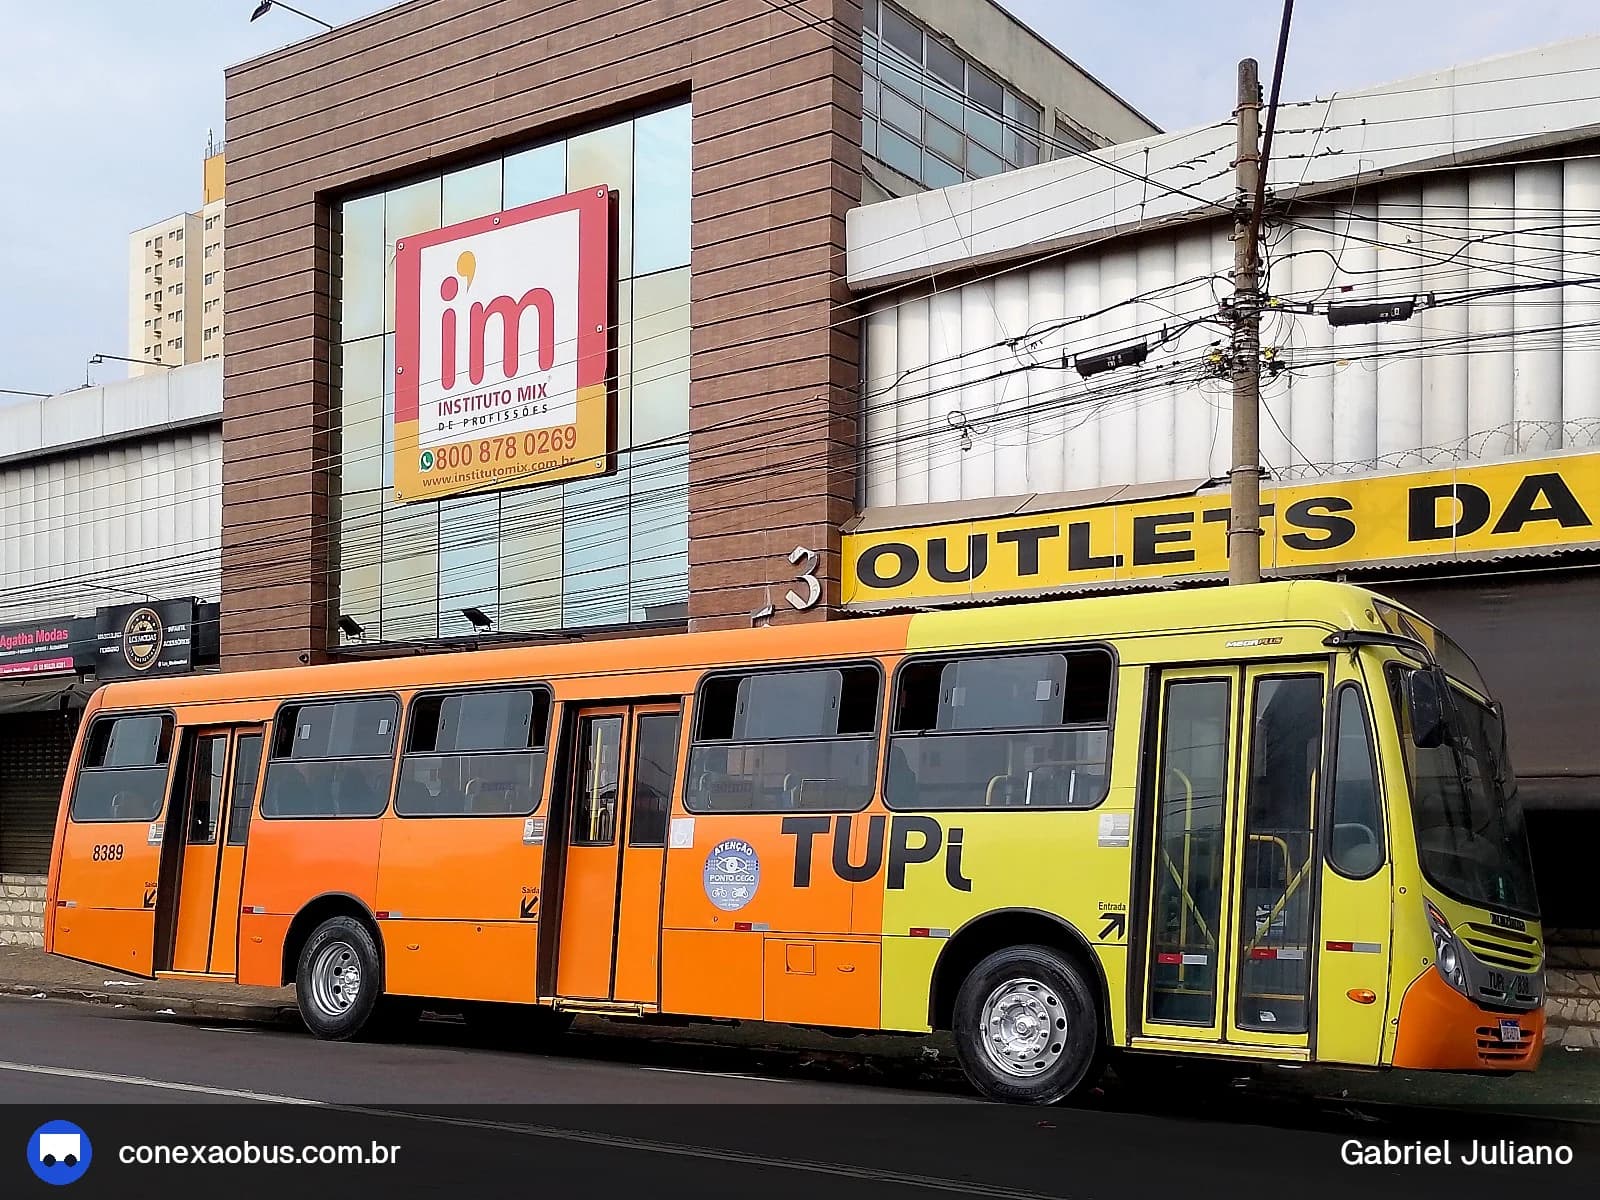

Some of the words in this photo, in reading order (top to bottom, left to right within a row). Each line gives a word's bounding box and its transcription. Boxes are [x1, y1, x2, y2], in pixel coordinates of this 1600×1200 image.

[438, 389, 511, 416] INSTITUTO
[517, 382, 548, 402] MIX
[438, 420, 453, 431] DE
[463, 404, 548, 427] PROFISSÕES
[436, 444, 473, 470] 800
[479, 436, 517, 463] 878
[523, 426, 577, 456] 0269
[422, 455, 576, 487] www.institutomix.com.br
[1407, 472, 1593, 542] DA
[0, 632, 34, 650] Agatha
[35, 628, 69, 643] Modas
[92, 844, 124, 862] 8389
[714, 841, 753, 856] ATENÇÃO
[709, 874, 735, 882] PONTO
[735, 874, 755, 882] CEGO
[1098, 901, 1126, 911] Entrada
